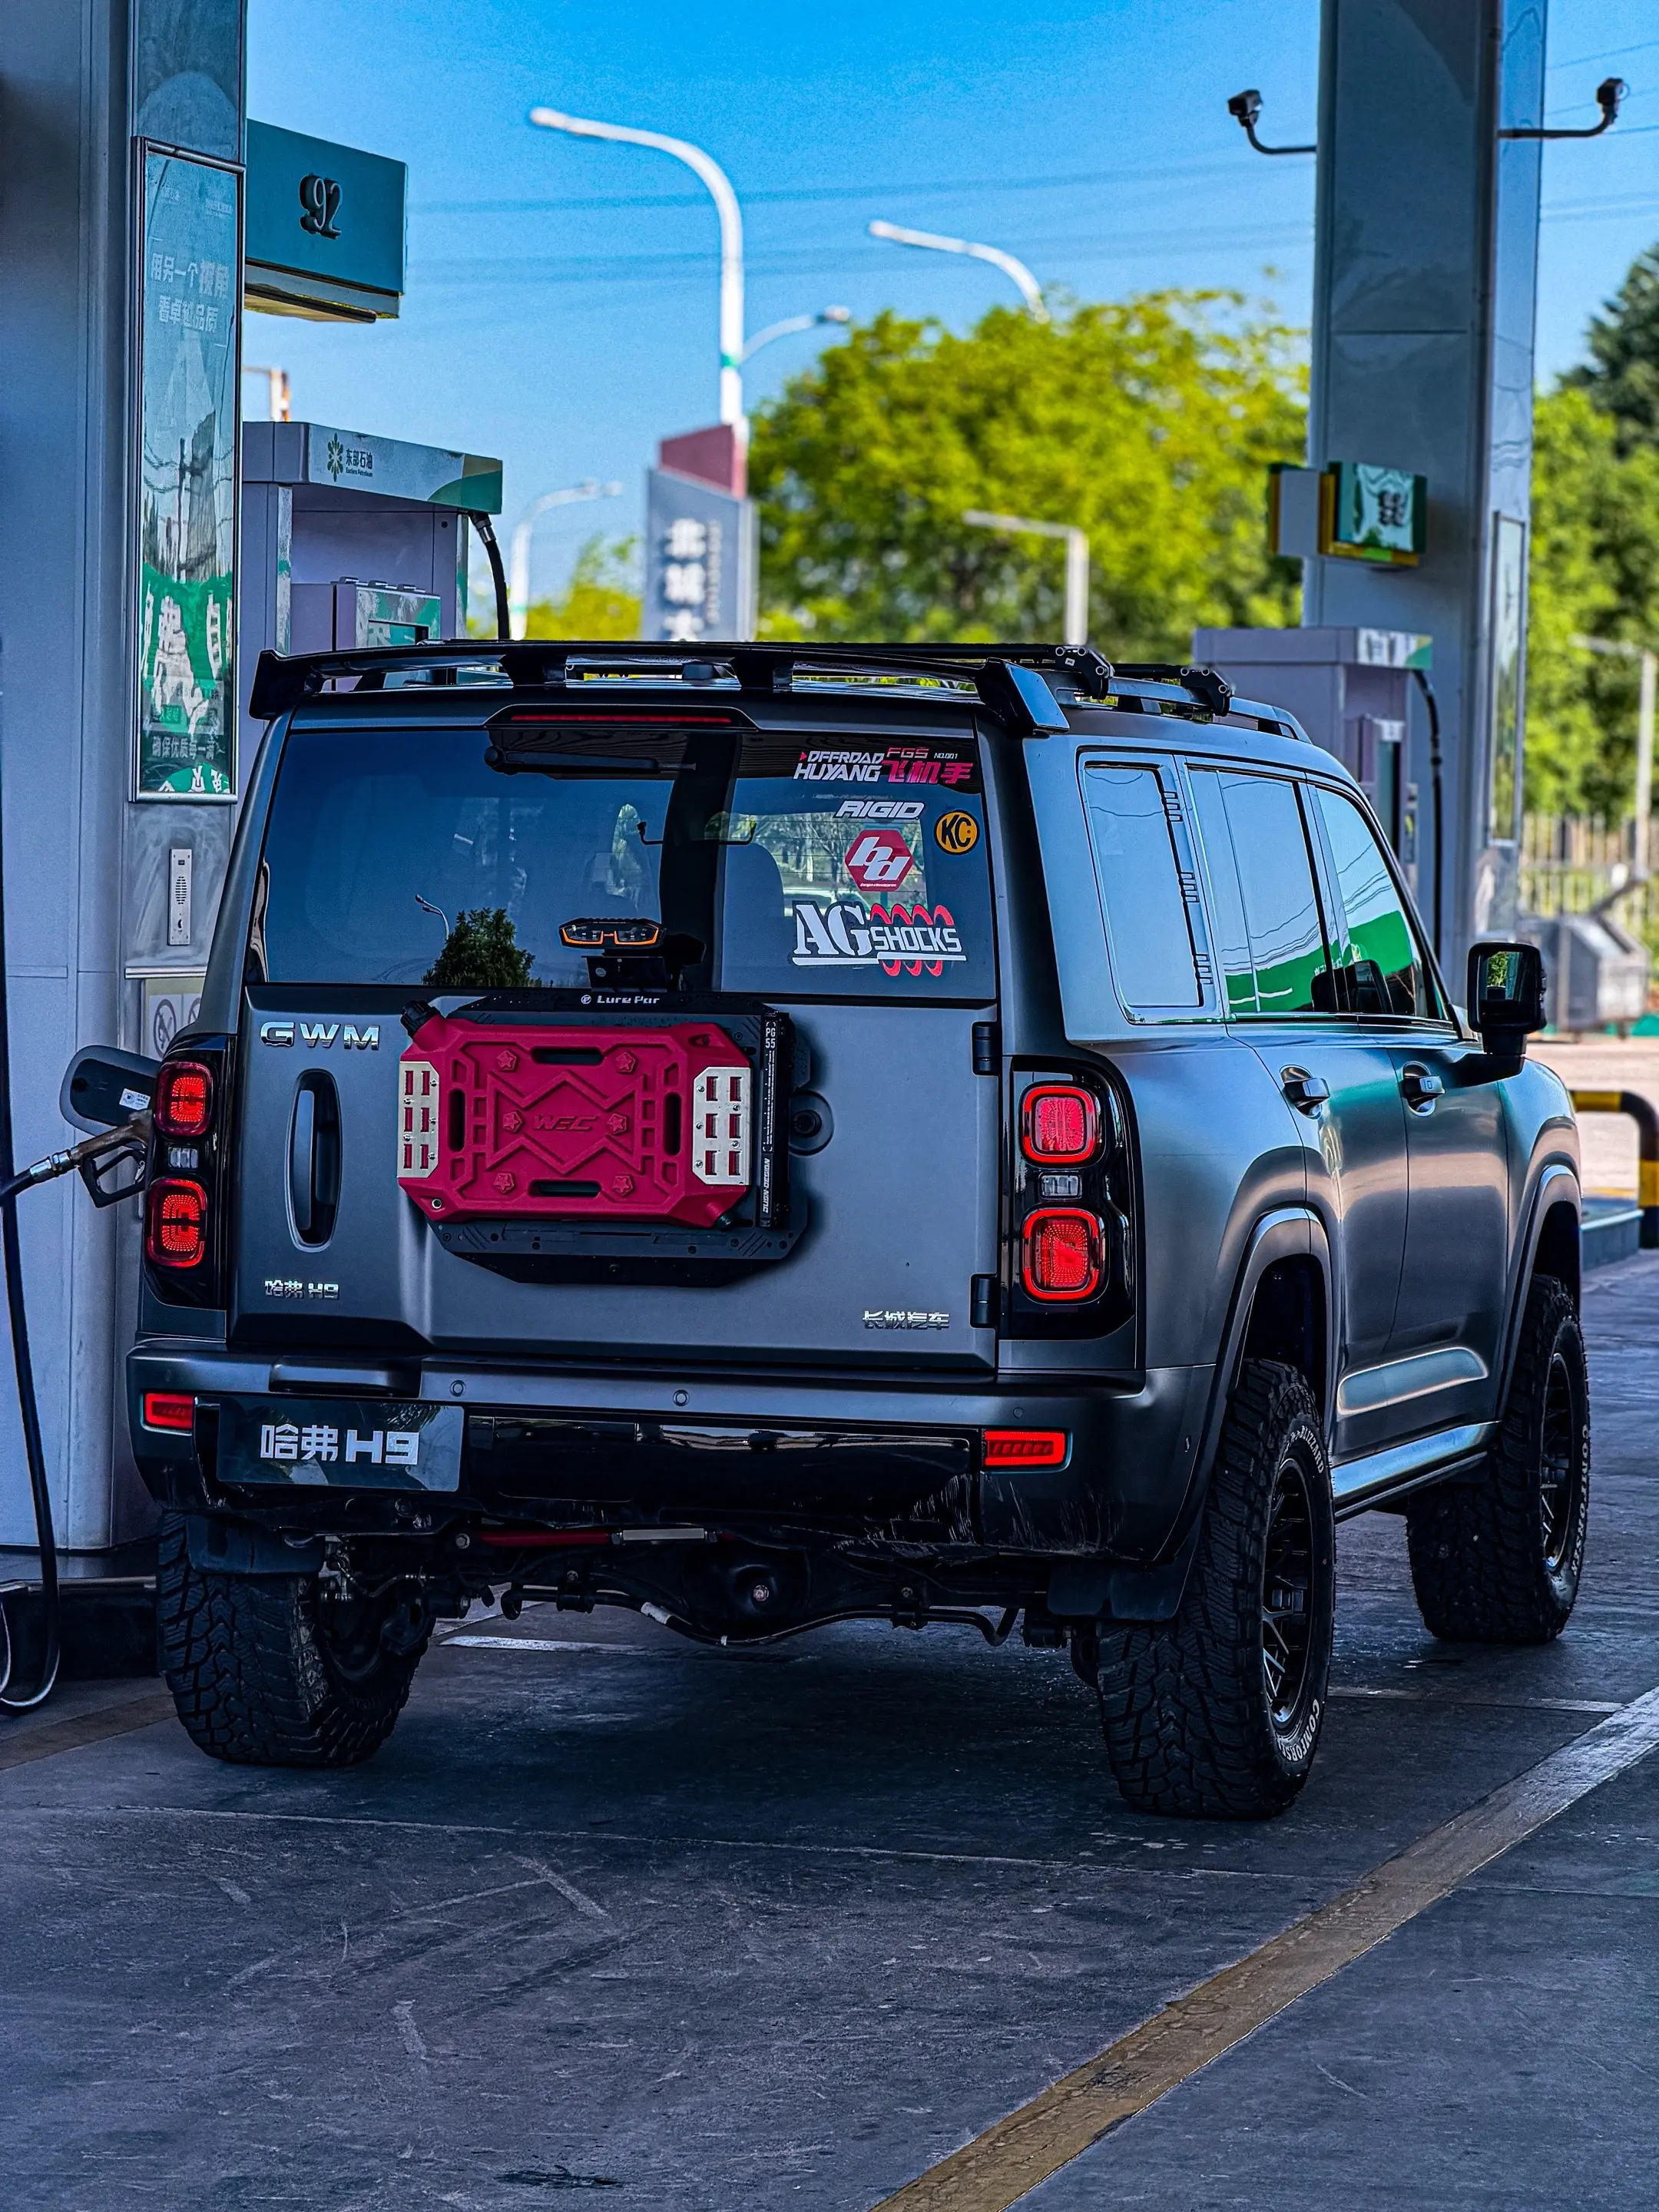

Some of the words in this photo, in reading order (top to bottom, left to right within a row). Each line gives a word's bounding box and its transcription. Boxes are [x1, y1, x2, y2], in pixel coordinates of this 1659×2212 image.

[299, 174, 343, 240] 92
[346, 449, 373, 469] 东部石油
[806, 750, 884, 764] OFFROAD
[886, 747, 929, 759] FGS
[793, 763, 882, 782] HUYANG
[882, 760, 973, 784] 飞机手
[836, 801, 924, 819] RIGID
[260, 1022, 381, 1050] GWM
[765, 1027, 776, 1037] PG
[765, 1038, 776, 1048] 55
[264, 1280, 303, 1299] 哈弗
[308, 1283, 339, 1300] H9
[863, 1310, 951, 1330] 长城汽车
[260, 1425, 339, 1462] 哈弗
[345, 1429, 420, 1465] H9
[1300, 1425, 1324, 1473] BLIZZARD
